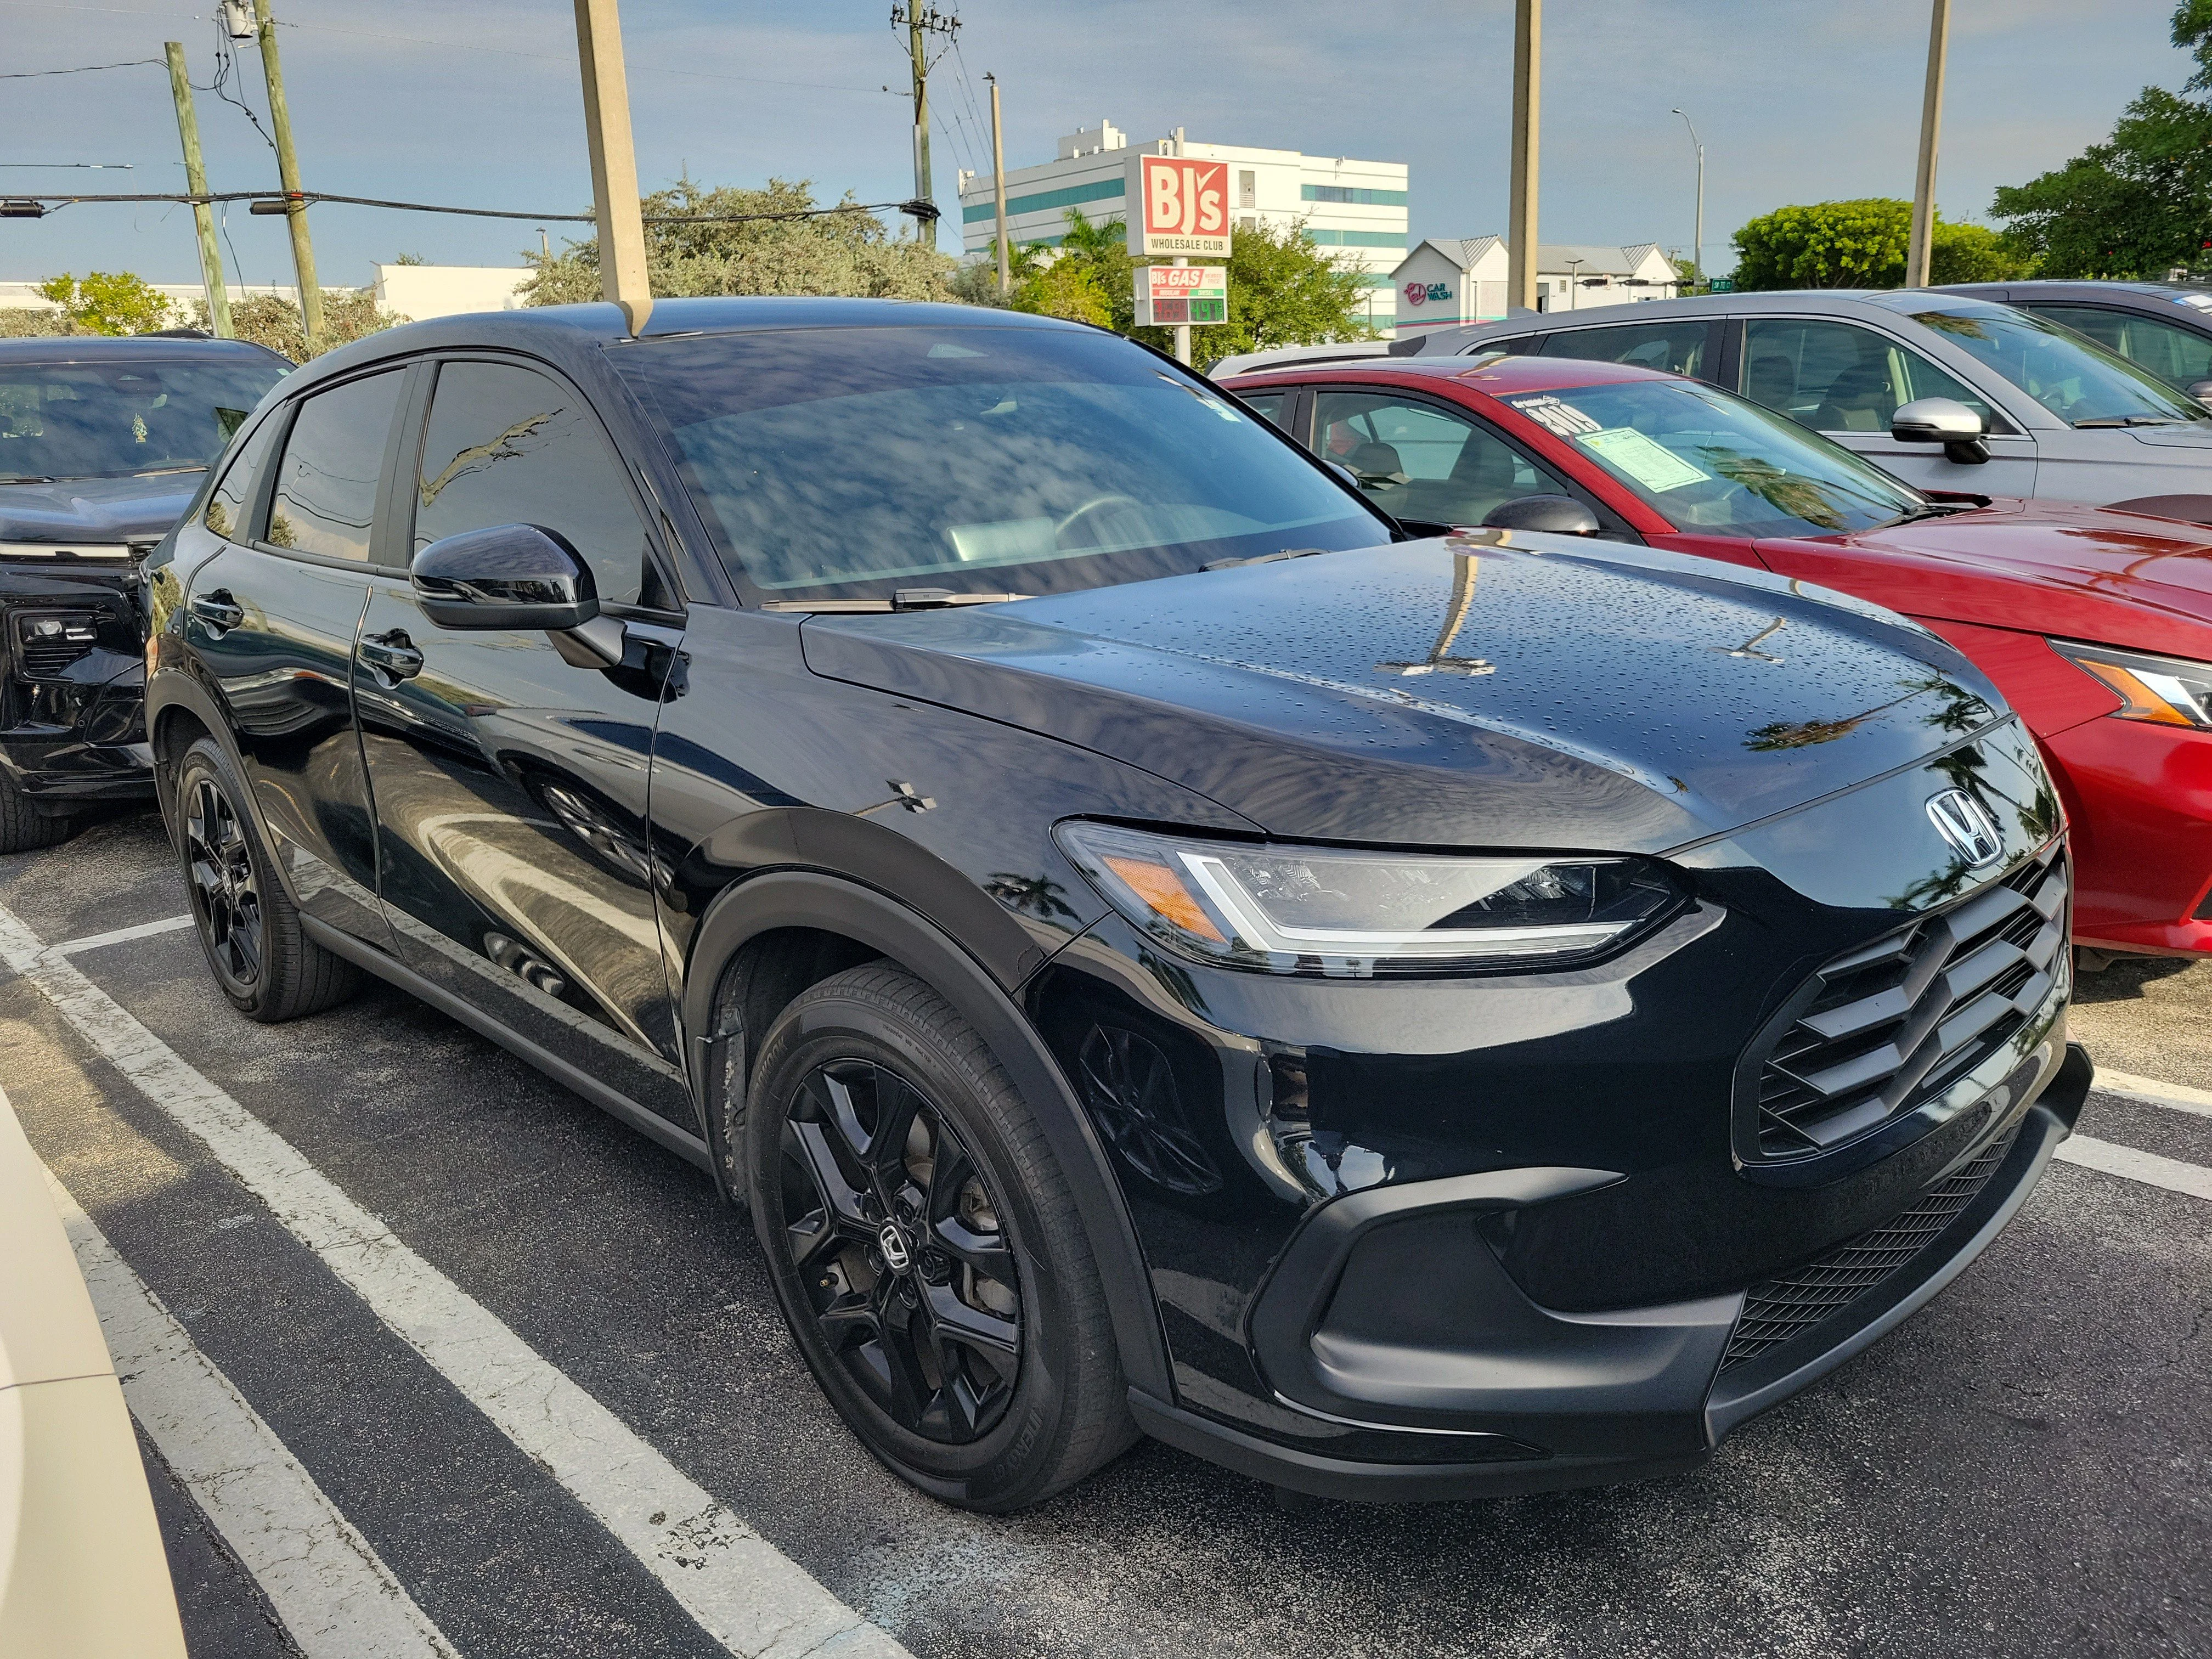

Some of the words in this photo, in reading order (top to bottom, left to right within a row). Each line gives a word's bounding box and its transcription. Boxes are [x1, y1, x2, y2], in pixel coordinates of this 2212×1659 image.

[1151, 238, 1200, 250] WHOLESALE
[1203, 240, 1223, 251] CLUB
[1168, 269, 1201, 286] GAS
[1427, 283, 1446, 292] CAR
[1427, 291, 1452, 301] WASH
